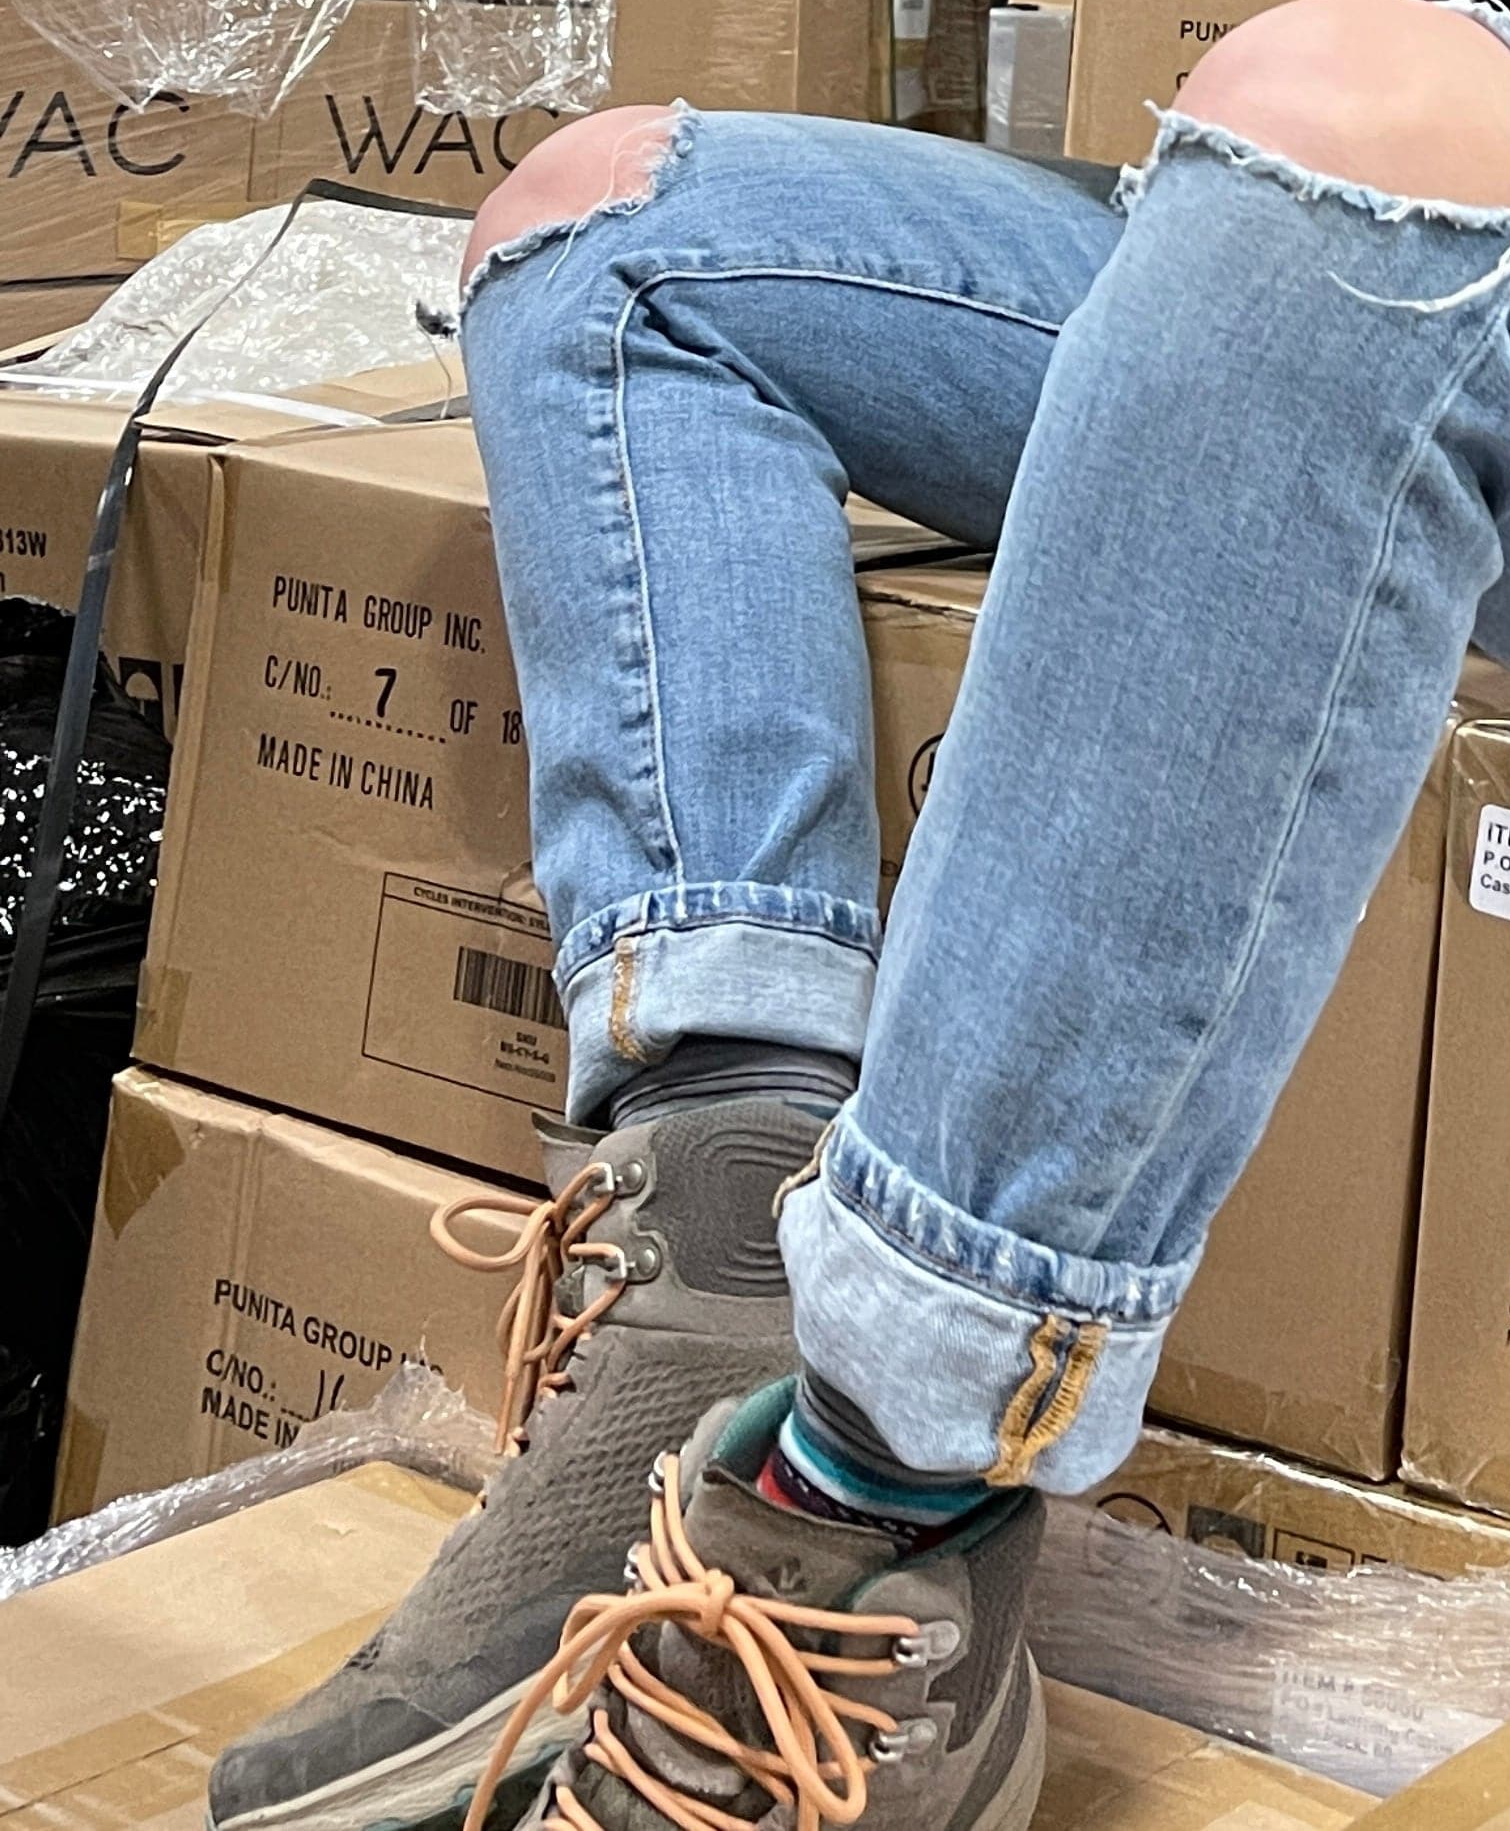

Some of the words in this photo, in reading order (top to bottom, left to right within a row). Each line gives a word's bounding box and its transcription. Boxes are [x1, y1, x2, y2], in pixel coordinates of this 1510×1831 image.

[0, 90, 190, 177] AC
[273, 575, 348, 623] PUNITA
[363, 595, 432, 639] GROUP
[444, 612, 486, 654] INC.
[264, 655, 332, 701] C/NO.:
[374, 667, 397, 718] 7
[450, 699, 478, 735] OF
[501, 710, 523, 745] 18
[257, 733, 322, 781] MADE
[329, 752, 353, 789] IN
[360, 761, 433, 811] CHINA
[413, 885, 449, 905] CYCLES
[214, 1278, 297, 1337] PUNITA
[303, 1316, 392, 1371] GROUP
[205, 1349, 276, 1402] C/NO.:
[201, 1386, 269, 1440] MADE
[274, 1417, 300, 1449] IN
